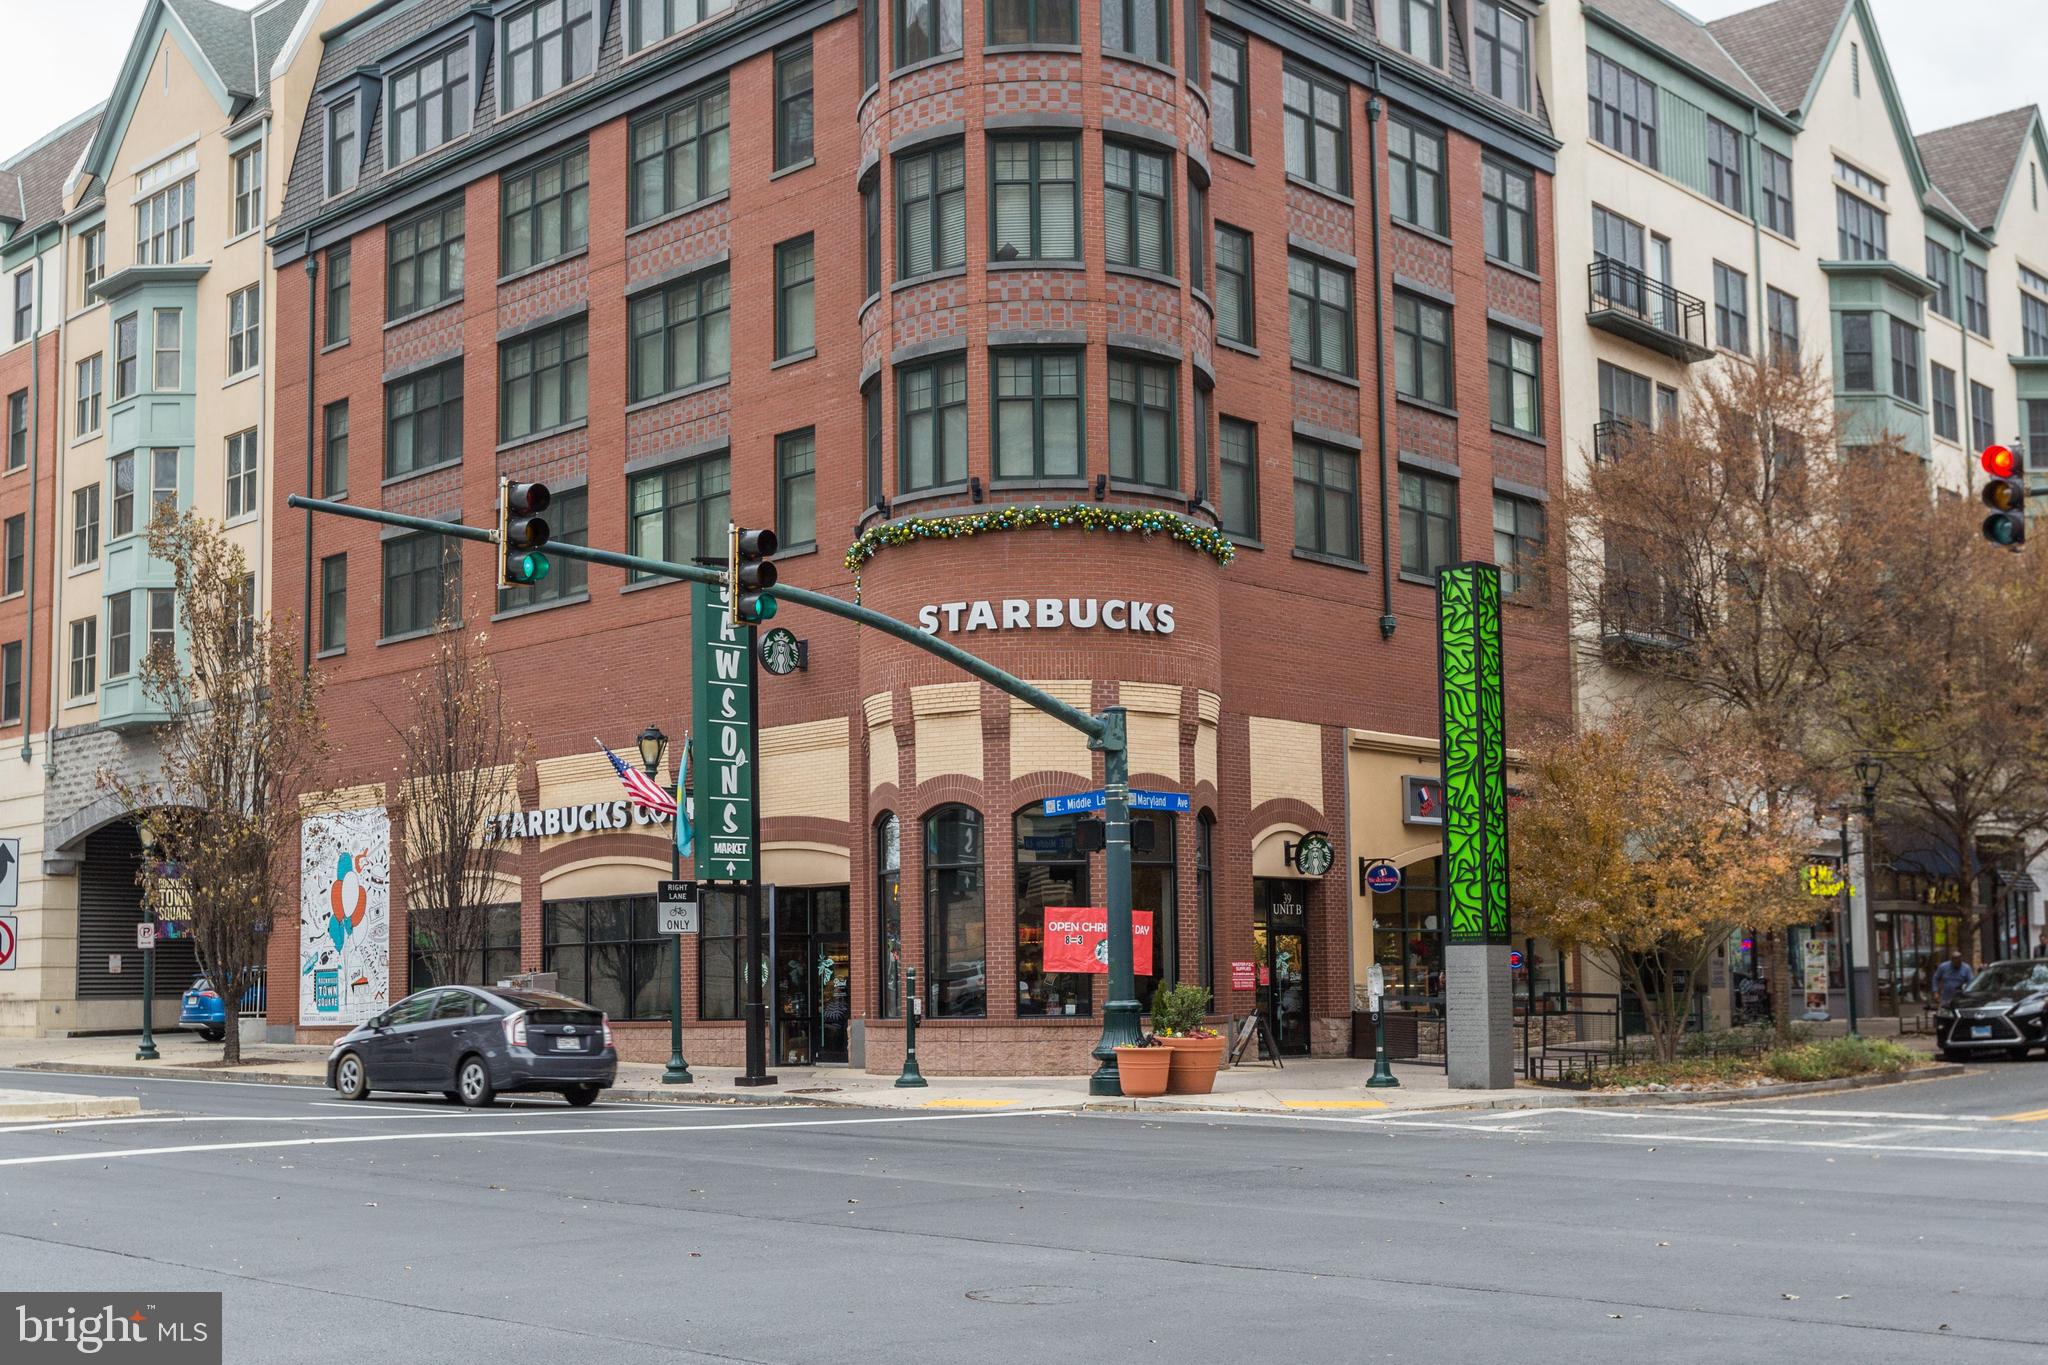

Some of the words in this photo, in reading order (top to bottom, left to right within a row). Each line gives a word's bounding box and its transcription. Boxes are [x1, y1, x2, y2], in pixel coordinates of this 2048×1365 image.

[918, 597, 1176, 634] STARBUCKS
[1056, 801, 1065, 811] E.
[1067, 797, 1091, 810] Middle
[1097, 795, 1106, 806] La
[1137, 795, 1166, 808] Maryland
[1177, 797, 1189, 808] Ave
[485, 800, 628, 843] STARBUCKS
[714, 842, 747, 854] MARKET
[667, 883, 688, 891] RIGHT
[158, 889, 193, 906] TOWN
[669, 892, 687, 900] LANE
[1283, 893, 1292, 903] 39
[158, 906, 193, 921] SQUARE
[1273, 904, 1294, 915] UNIT
[1296, 904, 1302, 915] B
[667, 920, 690, 930] ONLY
[1049, 922, 1079, 932] OPEN
[1082, 922, 1107, 933] CHRI
[1135, 925, 1150, 935] DAY
[318, 985, 338, 996] TOWN
[317, 998, 338, 1007] SQUARE
